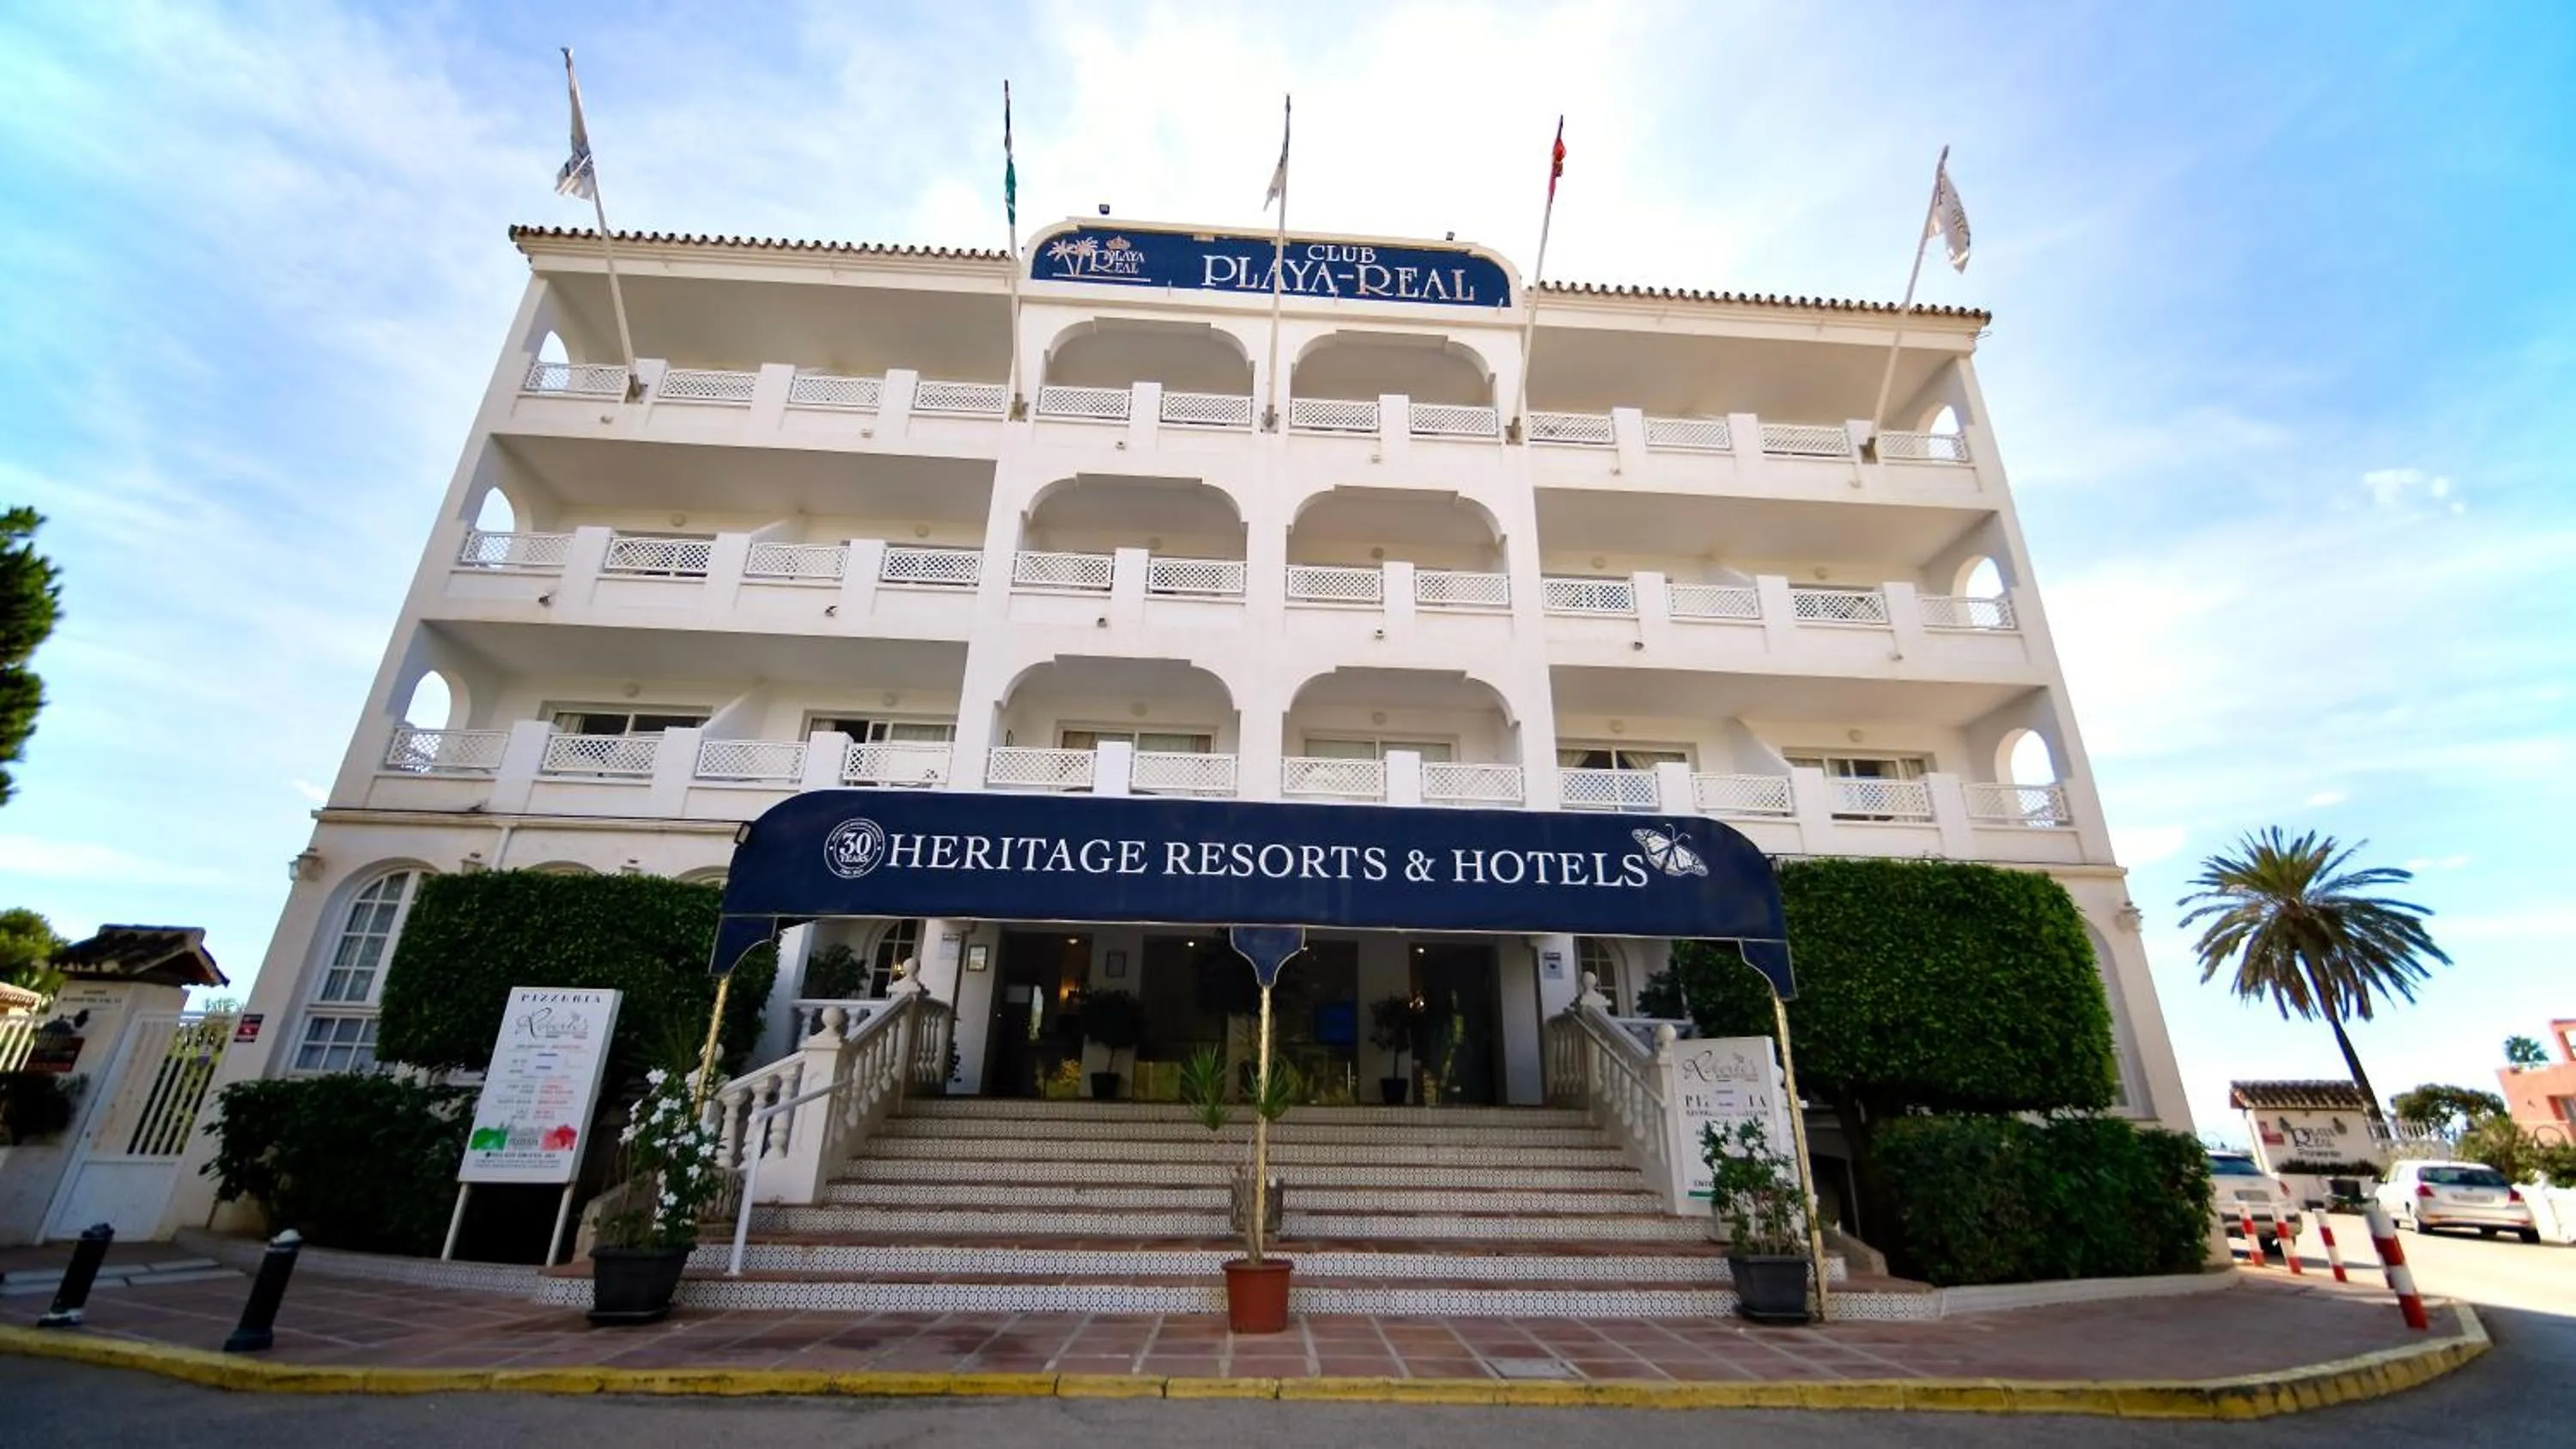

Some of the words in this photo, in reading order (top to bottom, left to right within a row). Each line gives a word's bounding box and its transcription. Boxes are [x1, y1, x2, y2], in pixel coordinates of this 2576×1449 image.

[1105, 249, 1145, 264] PLAYA
[1307, 244, 1377, 264] CLUB
[1200, 254, 1475, 301] PLAYA-REAL
[839, 832, 872, 855] 30
[885, 833, 1148, 874] HERITAGE
[1162, 841, 1388, 882] RESORTS
[1404, 849, 1435, 882] &
[1450, 849, 1649, 888] HOTELS
[521, 994, 601, 1003] PIZZERIA
